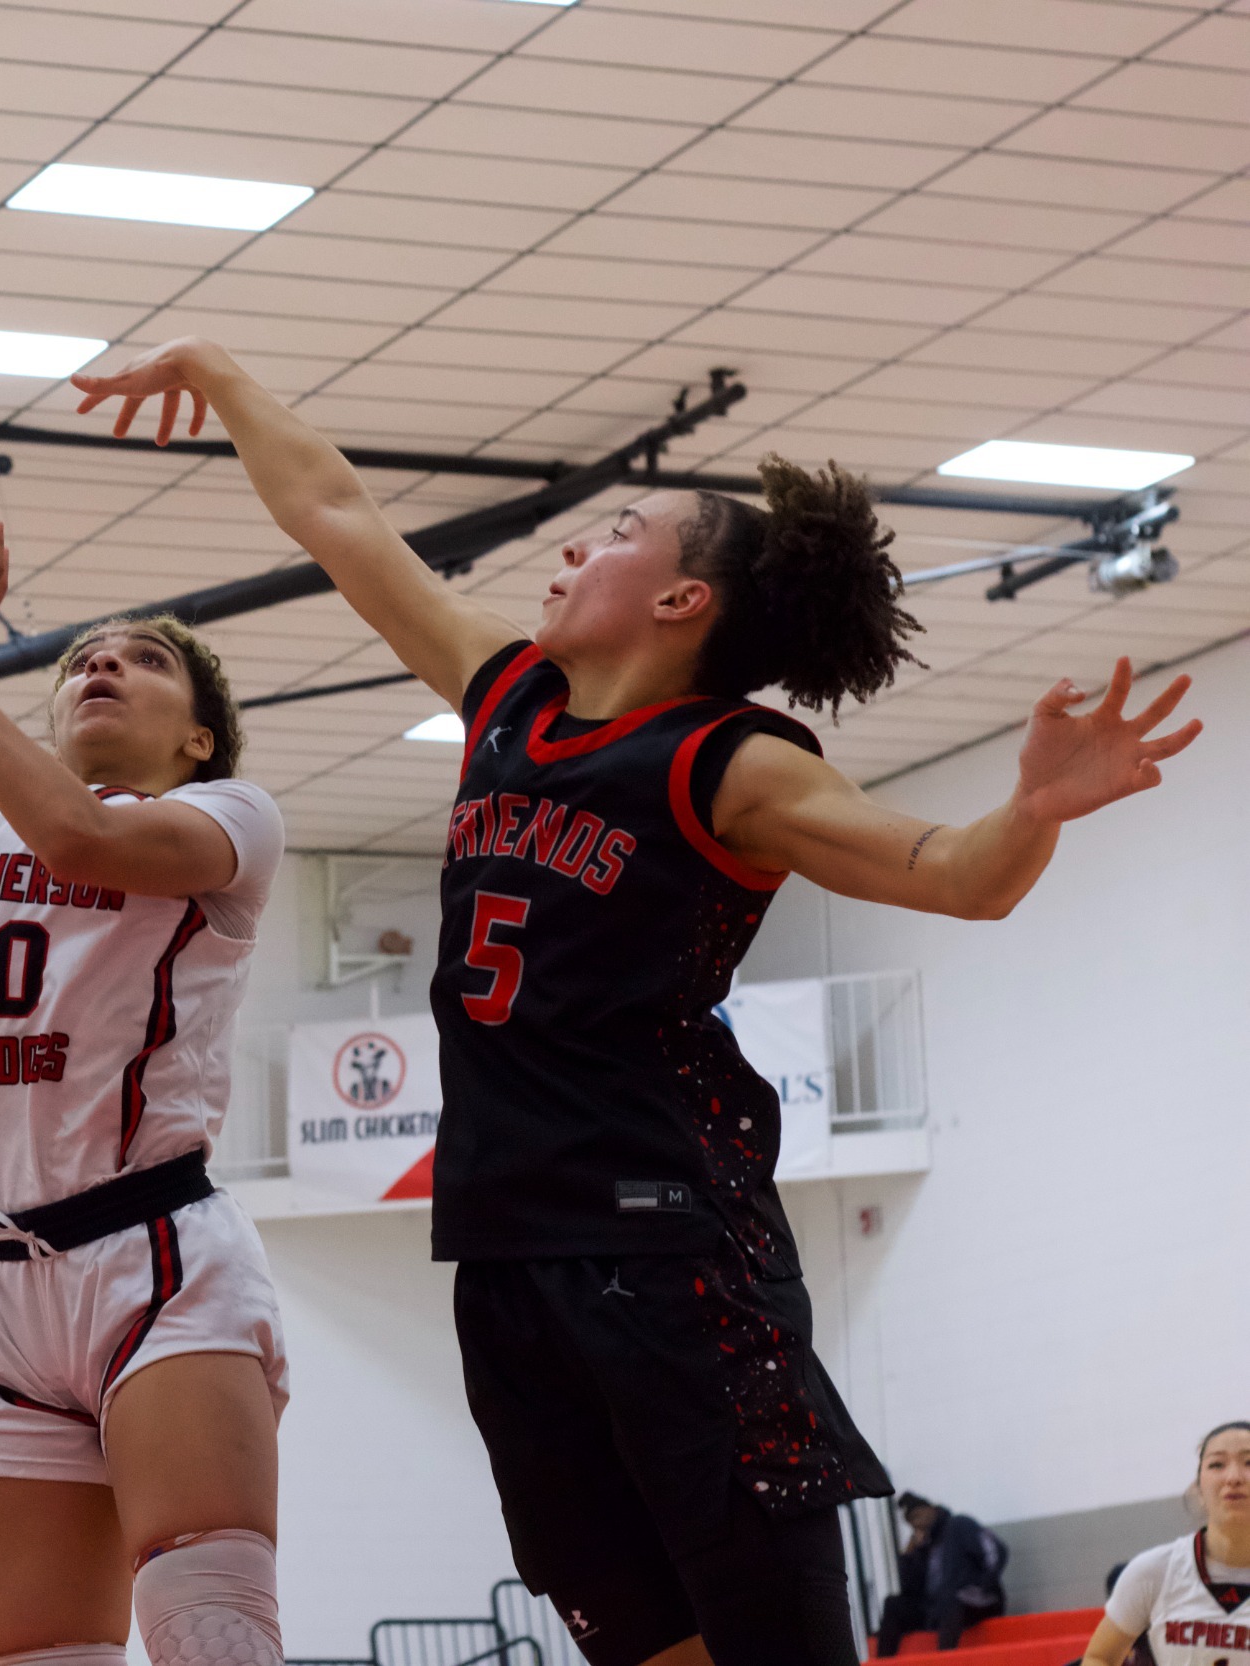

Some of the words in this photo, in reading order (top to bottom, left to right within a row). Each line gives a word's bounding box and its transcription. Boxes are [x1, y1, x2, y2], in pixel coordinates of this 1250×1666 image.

[460, 889, 532, 1027] 5
[301, 1116, 348, 1145] SLIM
[669, 1190, 682, 1203] M
[1166, 1620, 1250, 1651] MCPHER
